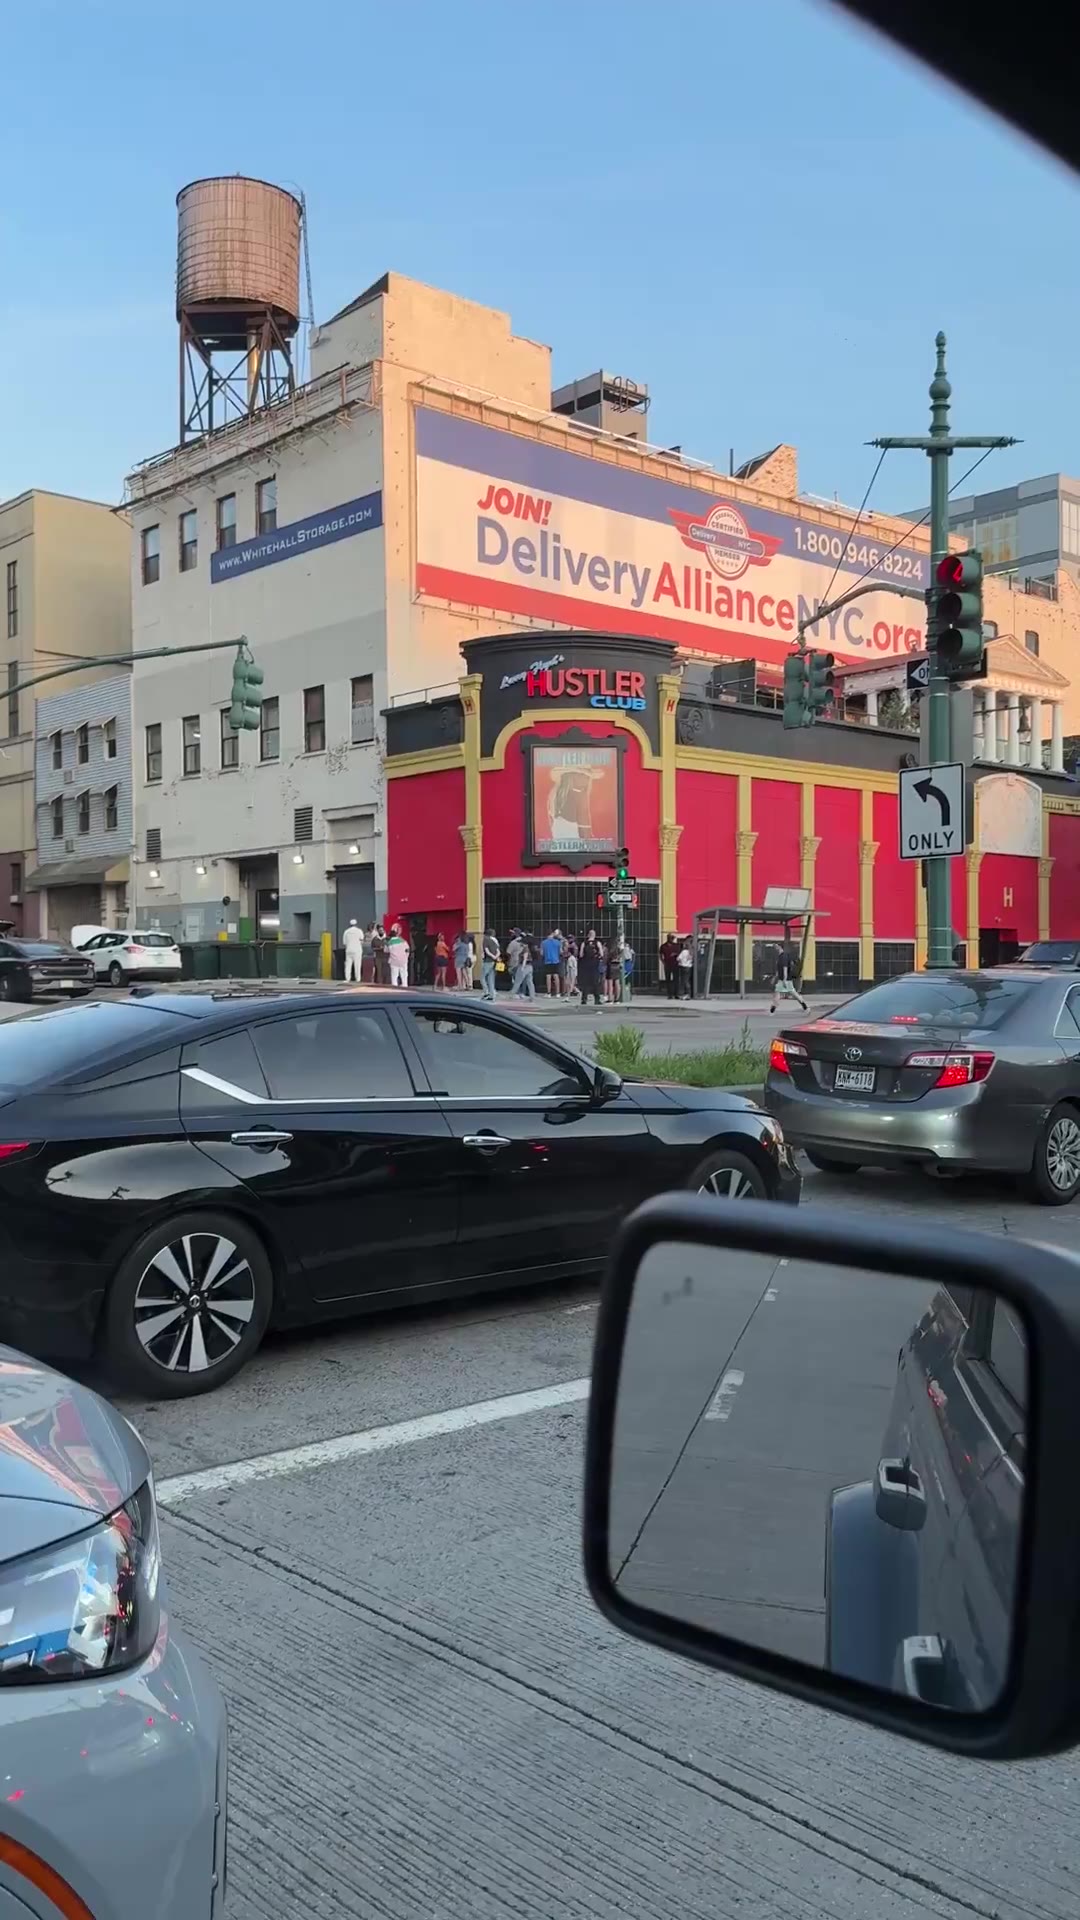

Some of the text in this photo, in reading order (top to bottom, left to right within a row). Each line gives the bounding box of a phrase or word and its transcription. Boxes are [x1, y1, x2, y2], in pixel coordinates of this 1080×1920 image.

[476, 484, 552, 525] JOIN!
[691, 527, 752, 550] Delivery NYC
[711, 520, 744, 535] CERTIFIED
[714, 549, 741, 561] MEMBER
[793, 526, 924, 580] 1.800.946.8224
[526, 667, 646, 698] HUSTLER
[590, 695, 647, 711] CLUB
[666, 699, 675, 712] H
[908, 829, 954, 851] ONLY
[1003, 886, 1013, 908] H
